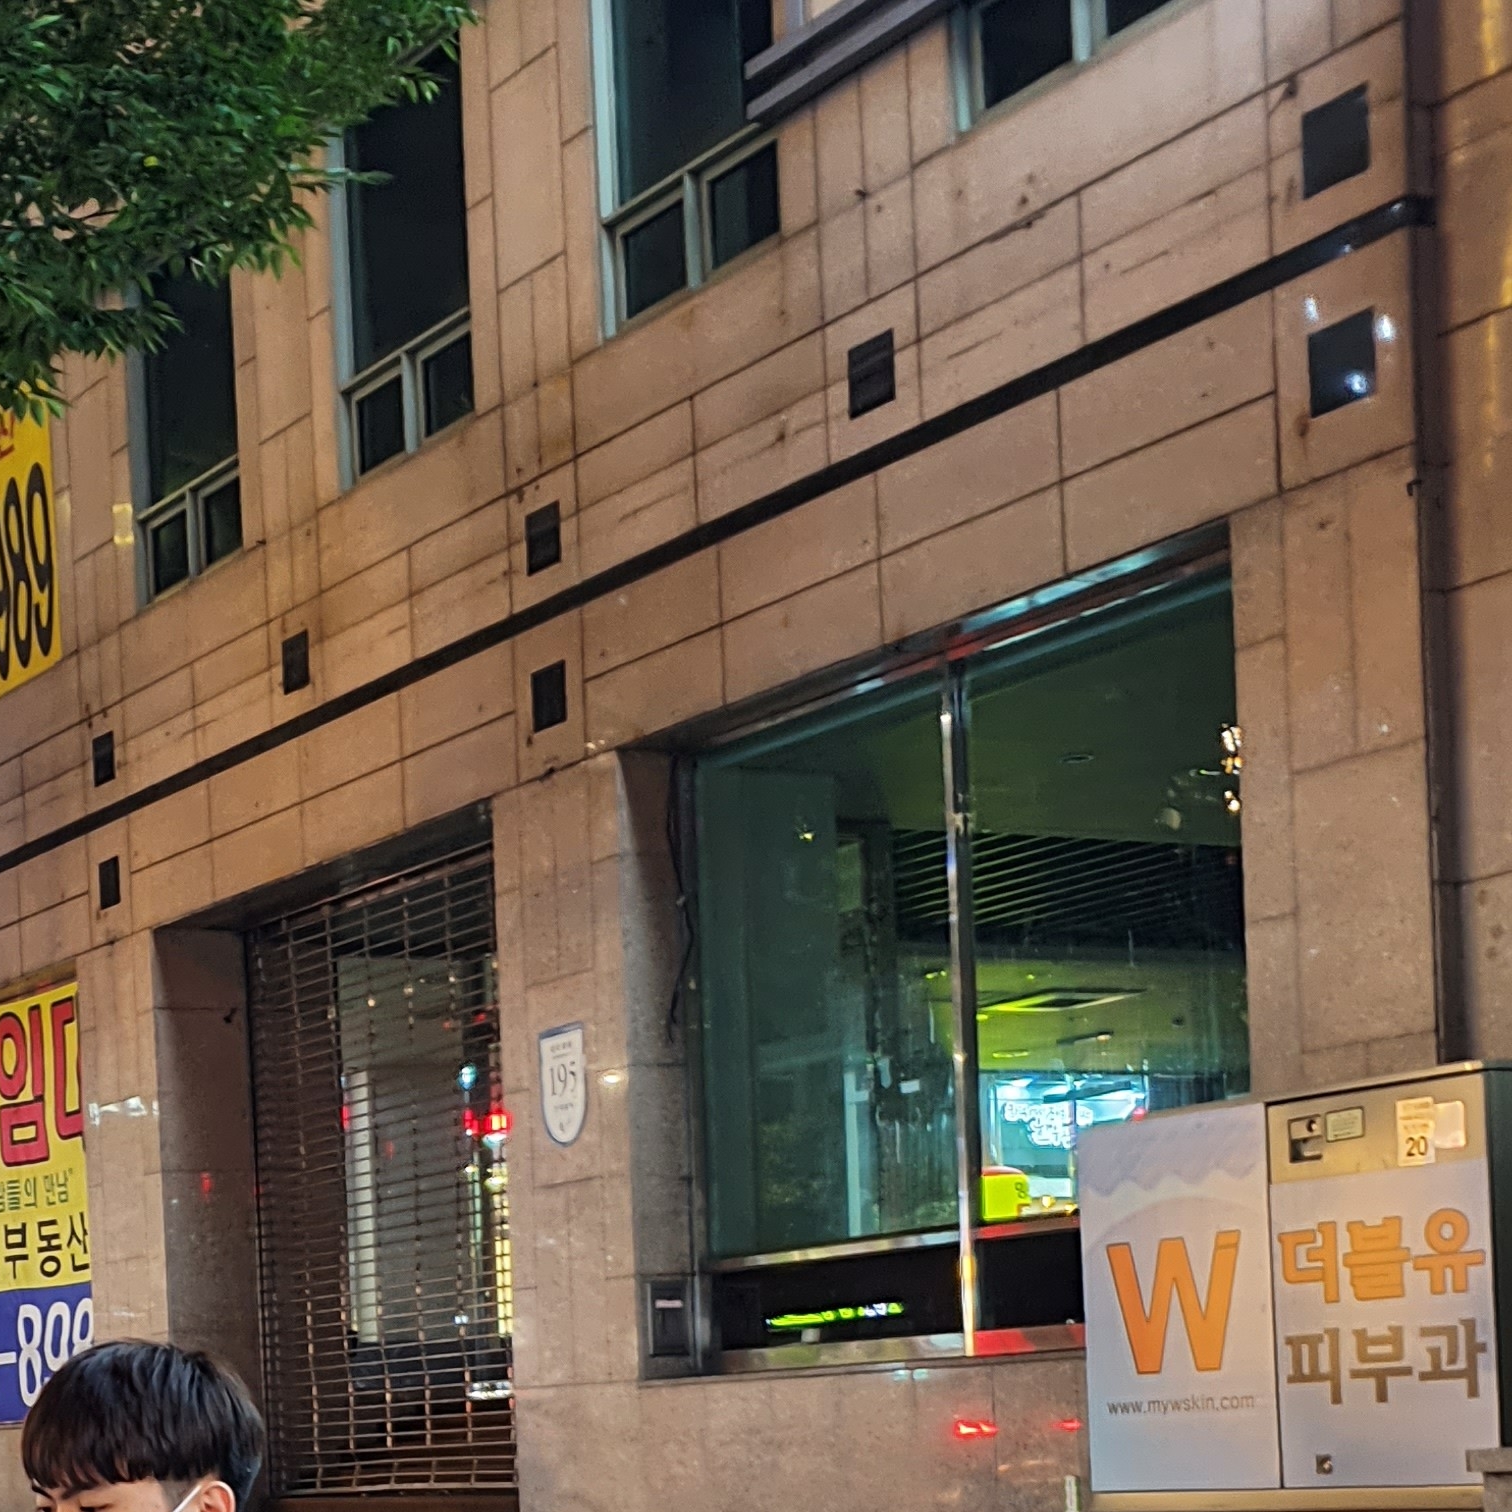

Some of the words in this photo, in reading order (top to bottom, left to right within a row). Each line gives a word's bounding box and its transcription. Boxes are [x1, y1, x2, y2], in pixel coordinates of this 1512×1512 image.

[549, 1060, 577, 1097] 195
[1406, 1136, 1428, 1157] 20
[1279, 1208, 1486, 1303] 더블유
[1106, 1229, 1241, 1375] W
[1285, 1318, 1486, 1404] 피부과
[1106, 1393, 1255, 1415] www.mywskin.com
